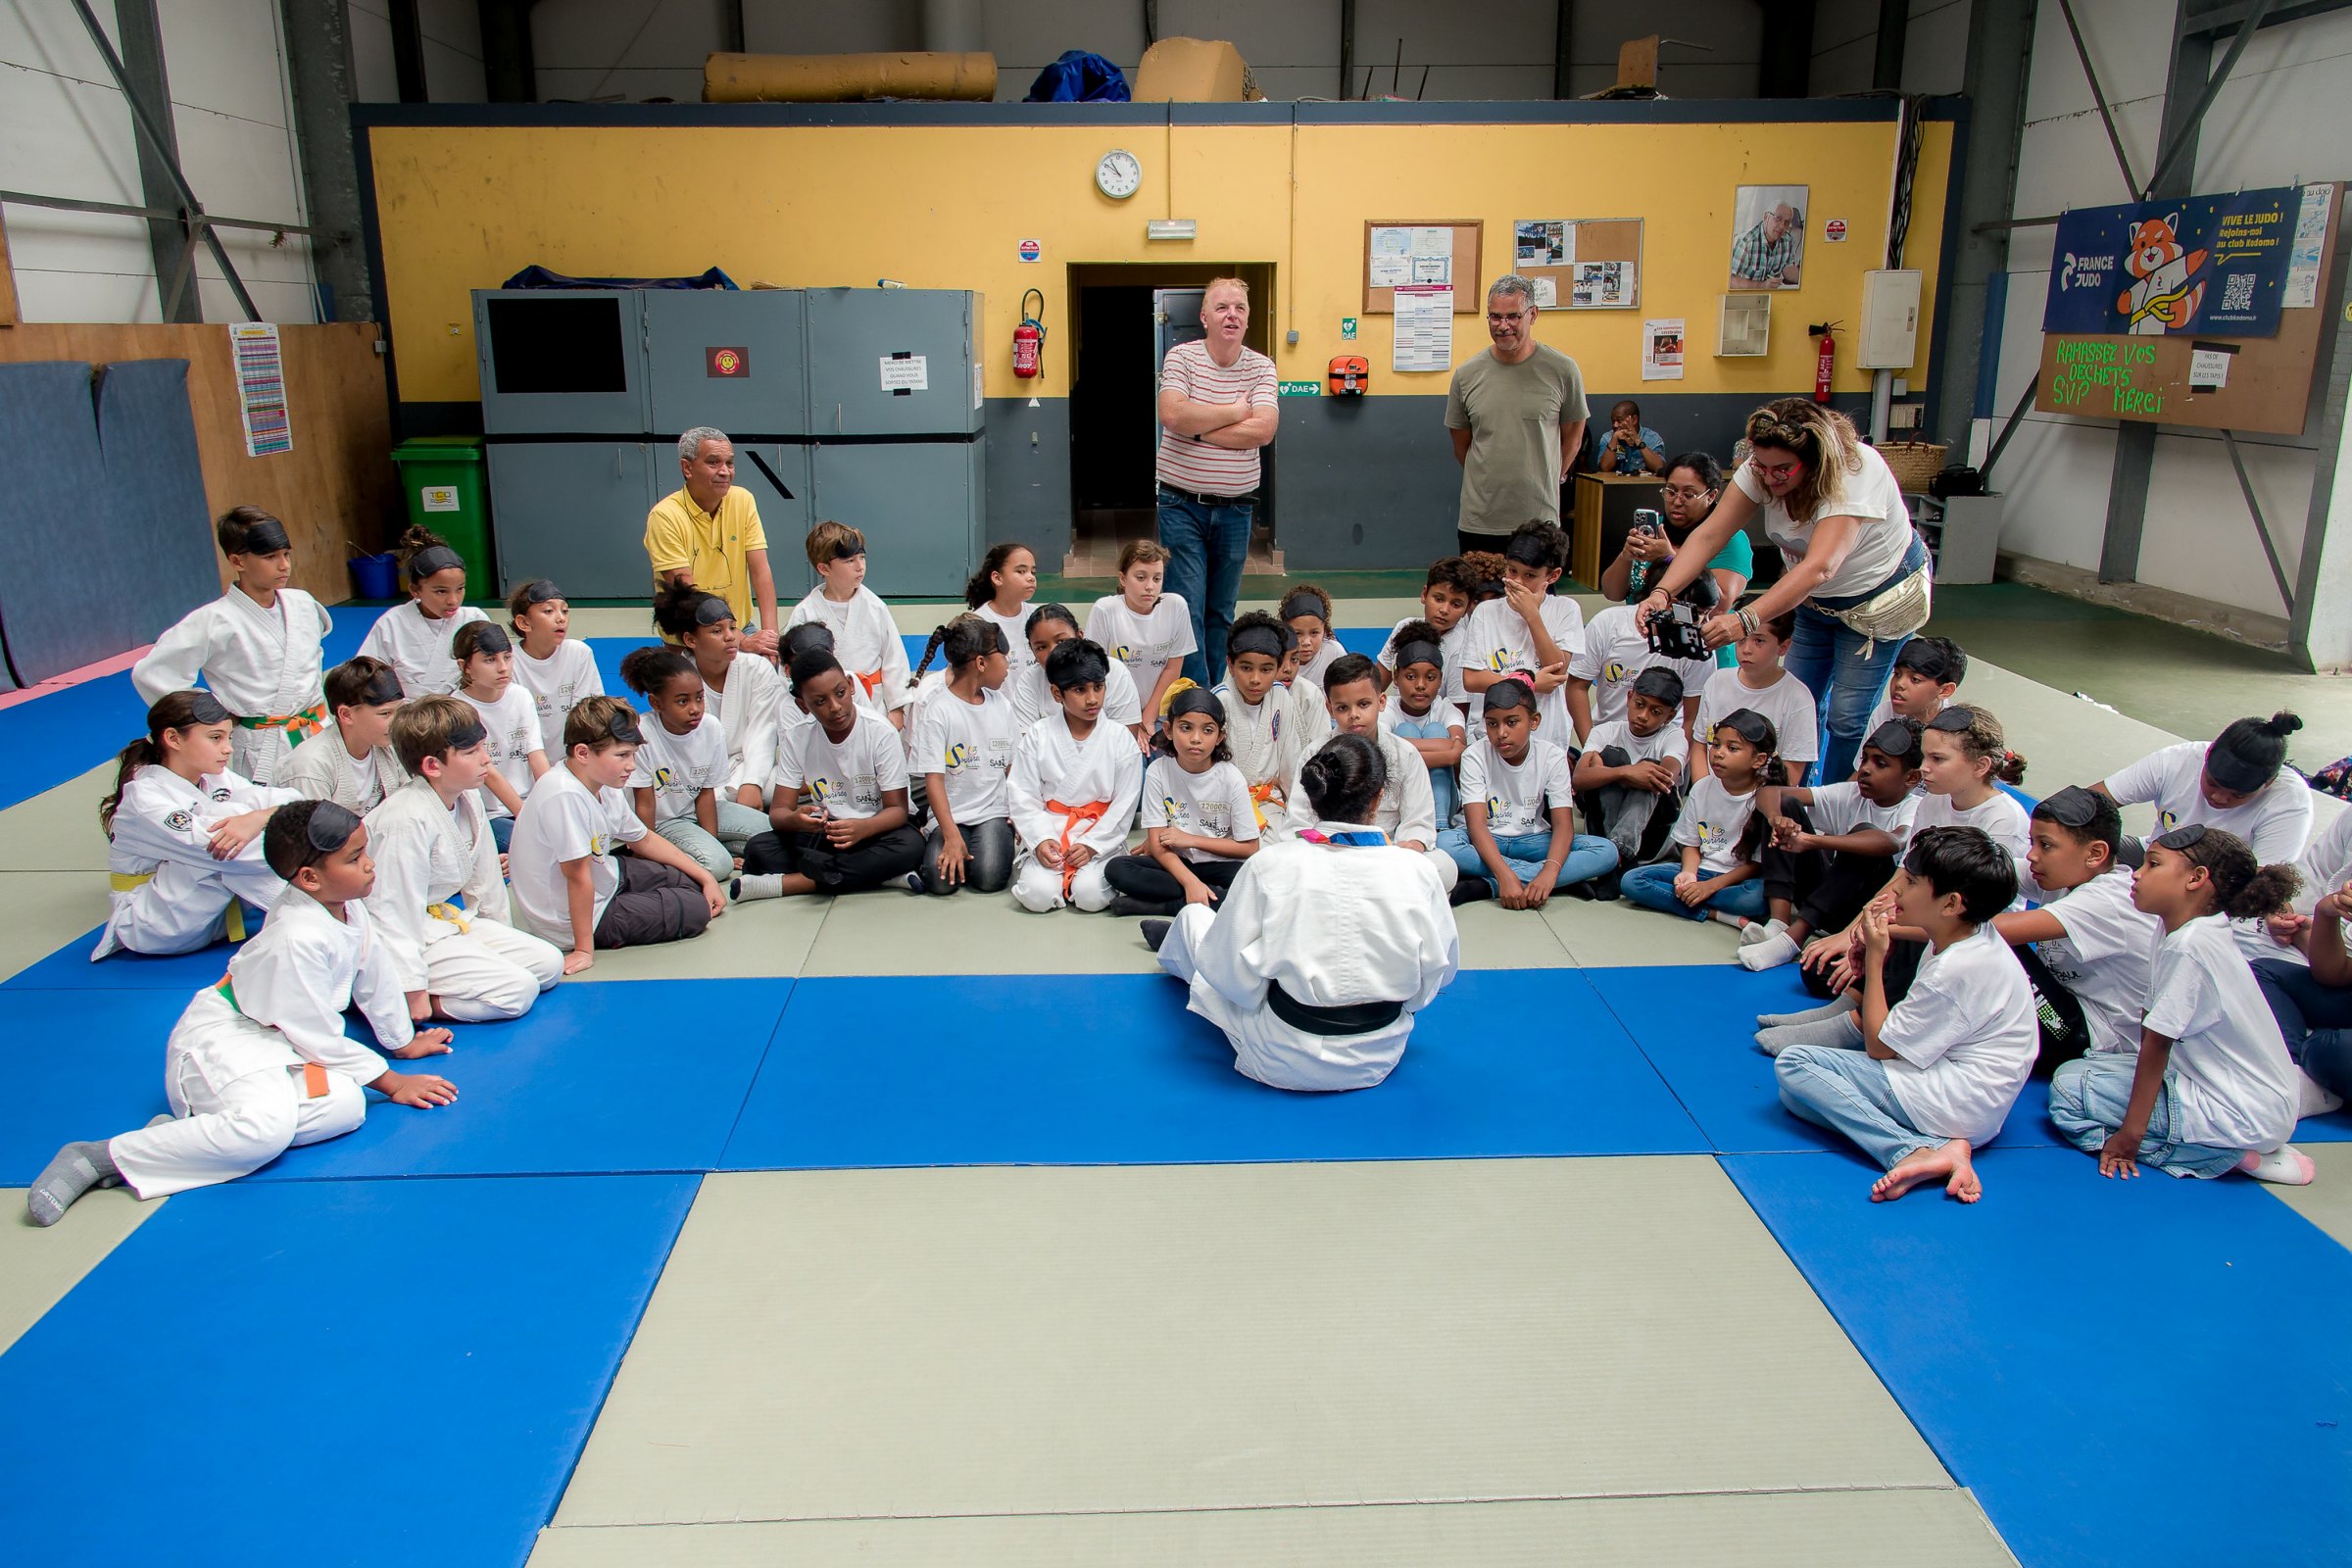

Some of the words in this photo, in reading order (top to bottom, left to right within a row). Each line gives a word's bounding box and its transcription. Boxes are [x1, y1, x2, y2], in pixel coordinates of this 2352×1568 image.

[2222, 215, 2243, 226] VIVE
[2244, 214, 2254, 225] LE
[2254, 213, 2278, 224] JUDO
[2219, 226, 2263, 239] Rejoins-moi
[2228, 239, 2245, 248] club
[2245, 237, 2276, 248] Kodomo
[2078, 256, 2115, 271] FRANCE
[2075, 272, 2101, 287] JUDO
[2056, 339, 2119, 365] RAMASSEZ
[2125, 343, 2156, 366] VOS
[2069, 363, 2133, 387] DECHETS
[2053, 374, 2090, 406] SVP
